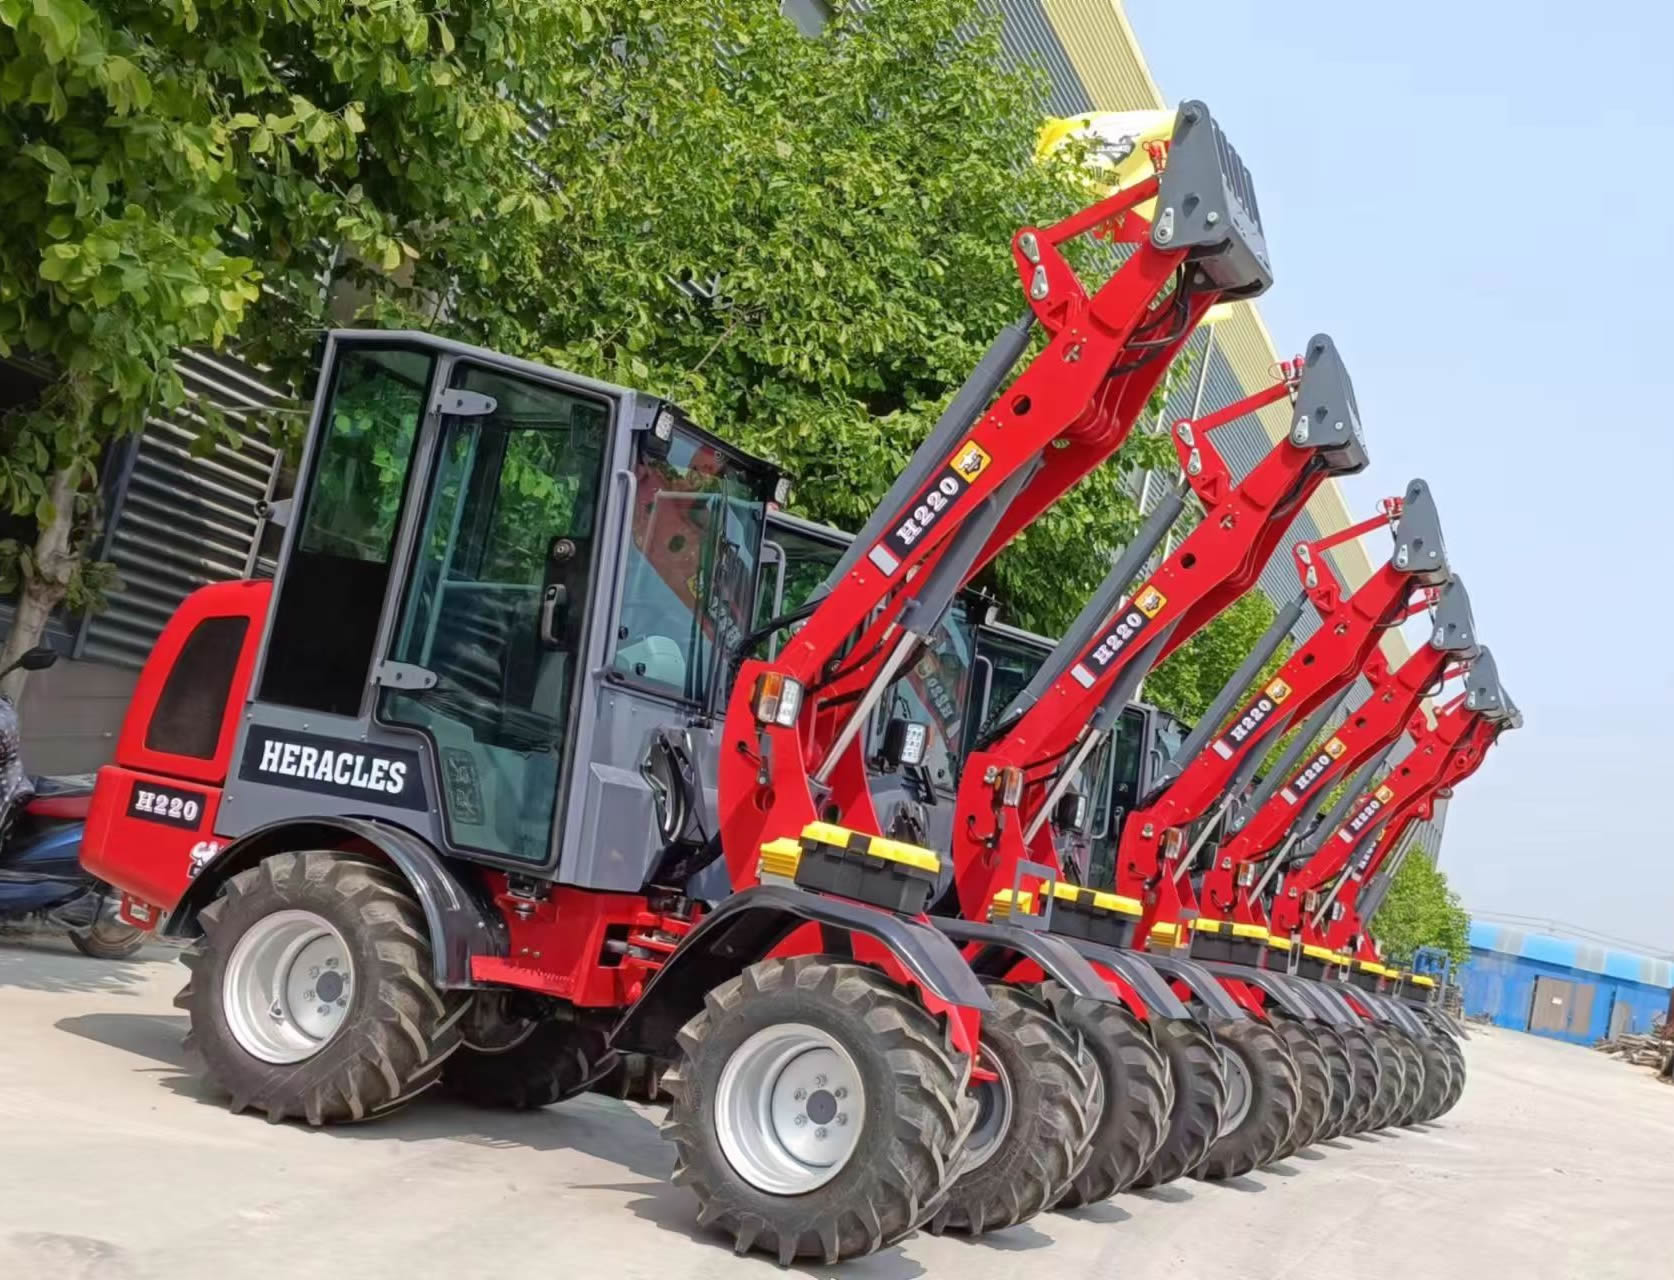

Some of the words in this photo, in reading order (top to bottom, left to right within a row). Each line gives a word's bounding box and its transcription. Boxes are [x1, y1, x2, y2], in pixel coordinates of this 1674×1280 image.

[896, 476, 959, 545] H220
[1092, 612, 1142, 665] H220
[1230, 699, 1272, 741] H220
[258, 740, 407, 794] HERACLES
[1295, 755, 1330, 790] H220
[135, 790, 199, 821] H220
[1350, 800, 1380, 831] H220
